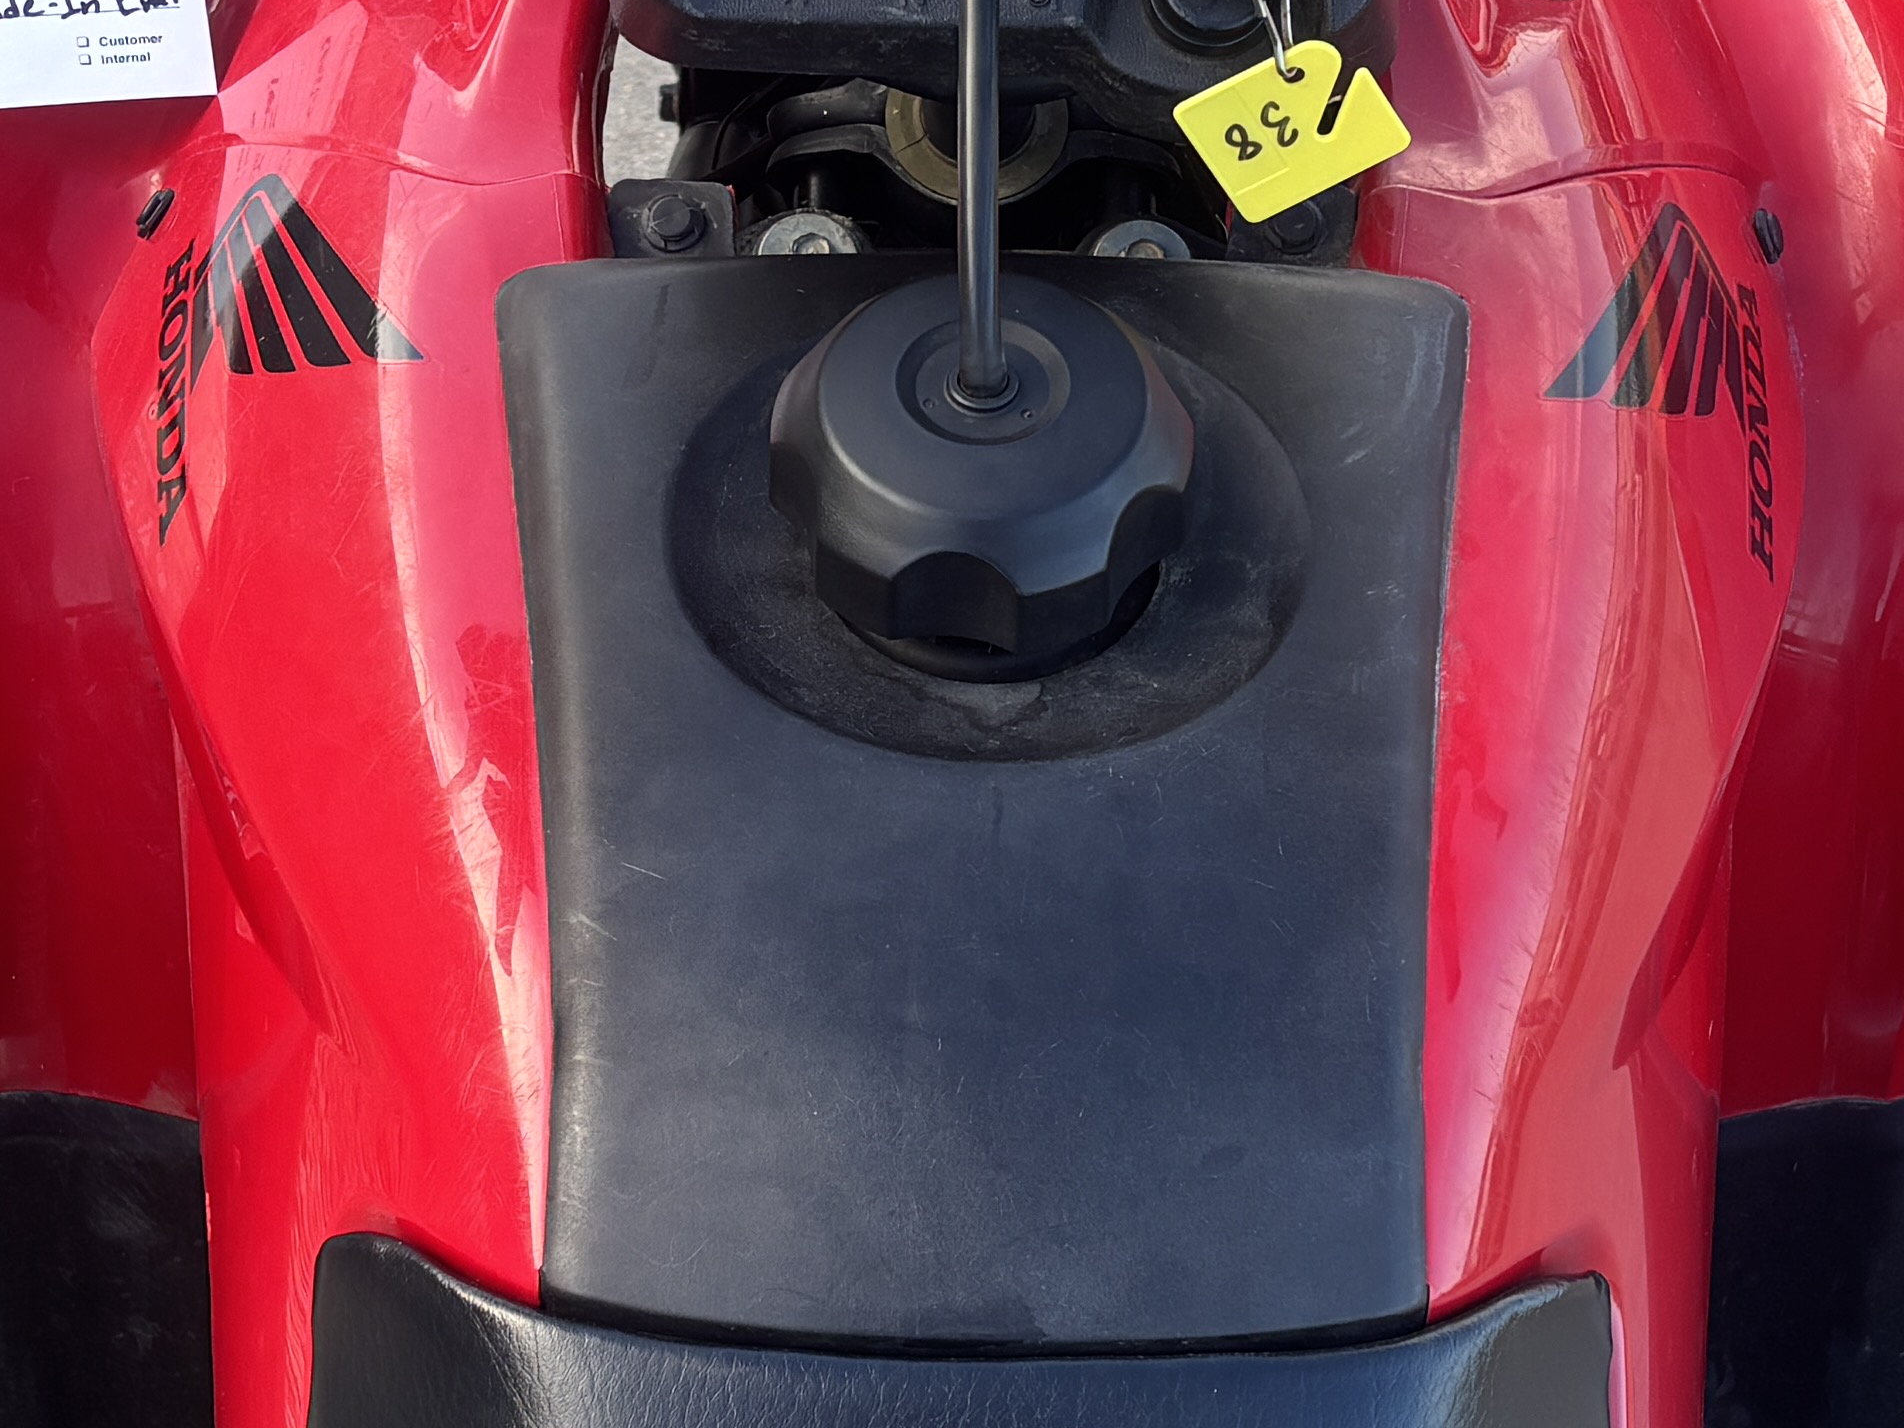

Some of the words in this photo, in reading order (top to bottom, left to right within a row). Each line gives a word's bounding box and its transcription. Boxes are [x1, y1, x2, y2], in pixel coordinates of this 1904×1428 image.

[98, 35, 163, 47] Customer
[100, 52, 151, 64] Internal
[1224, 101, 1299, 161] 38
[157, 238, 195, 548] HONDA
[1736, 278, 1774, 584] HONDA
